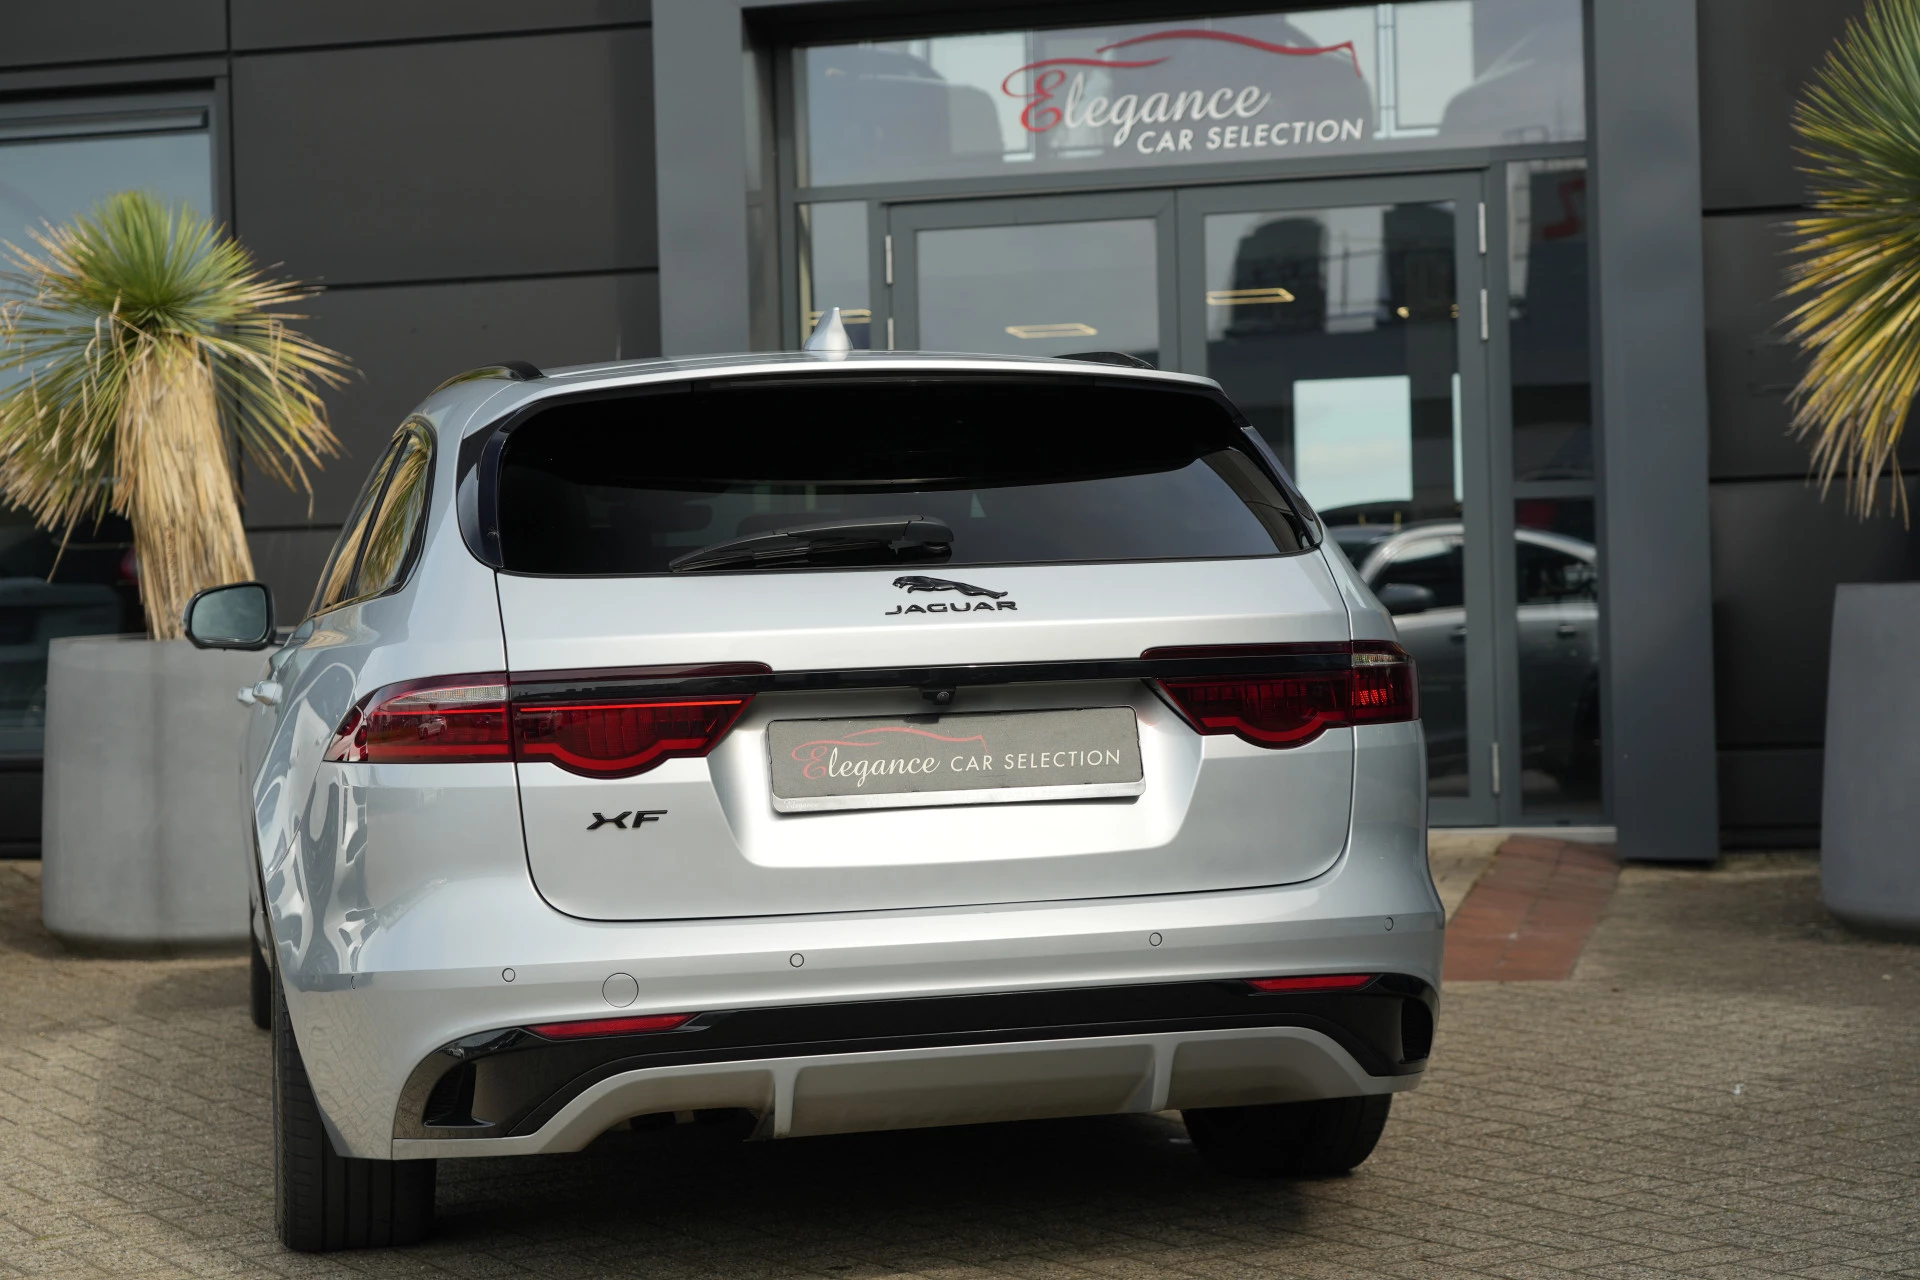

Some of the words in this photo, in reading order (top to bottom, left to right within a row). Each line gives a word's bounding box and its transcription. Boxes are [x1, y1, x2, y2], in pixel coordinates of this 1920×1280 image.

[1003, 62, 1271, 148] Elegance
[1136, 128, 1194, 155] CAR
[1205, 117, 1364, 150] SELECTION
[884, 600, 1018, 616] JAGUAR
[791, 741, 941, 788] Elegance
[949, 754, 994, 773] CAR
[1003, 749, 1121, 770] SELECTION
[586, 809, 669, 831] XF
